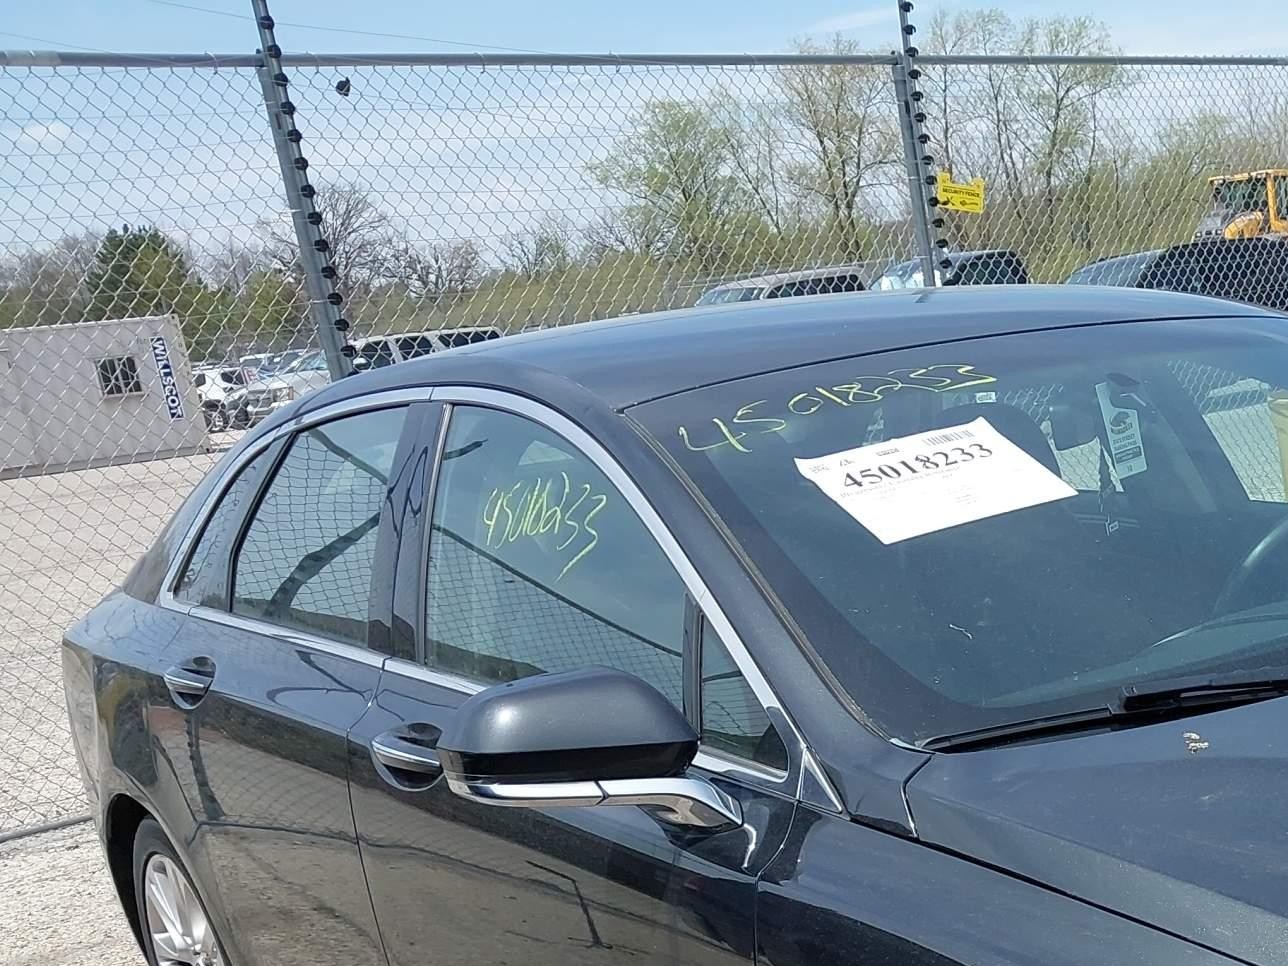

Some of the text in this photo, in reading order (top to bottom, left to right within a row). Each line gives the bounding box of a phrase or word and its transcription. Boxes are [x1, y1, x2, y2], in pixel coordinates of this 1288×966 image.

[152, 339, 183, 418] WILLSCOT
[678, 364, 997, 453] 45018233
[843, 443, 993, 488] 45018233
